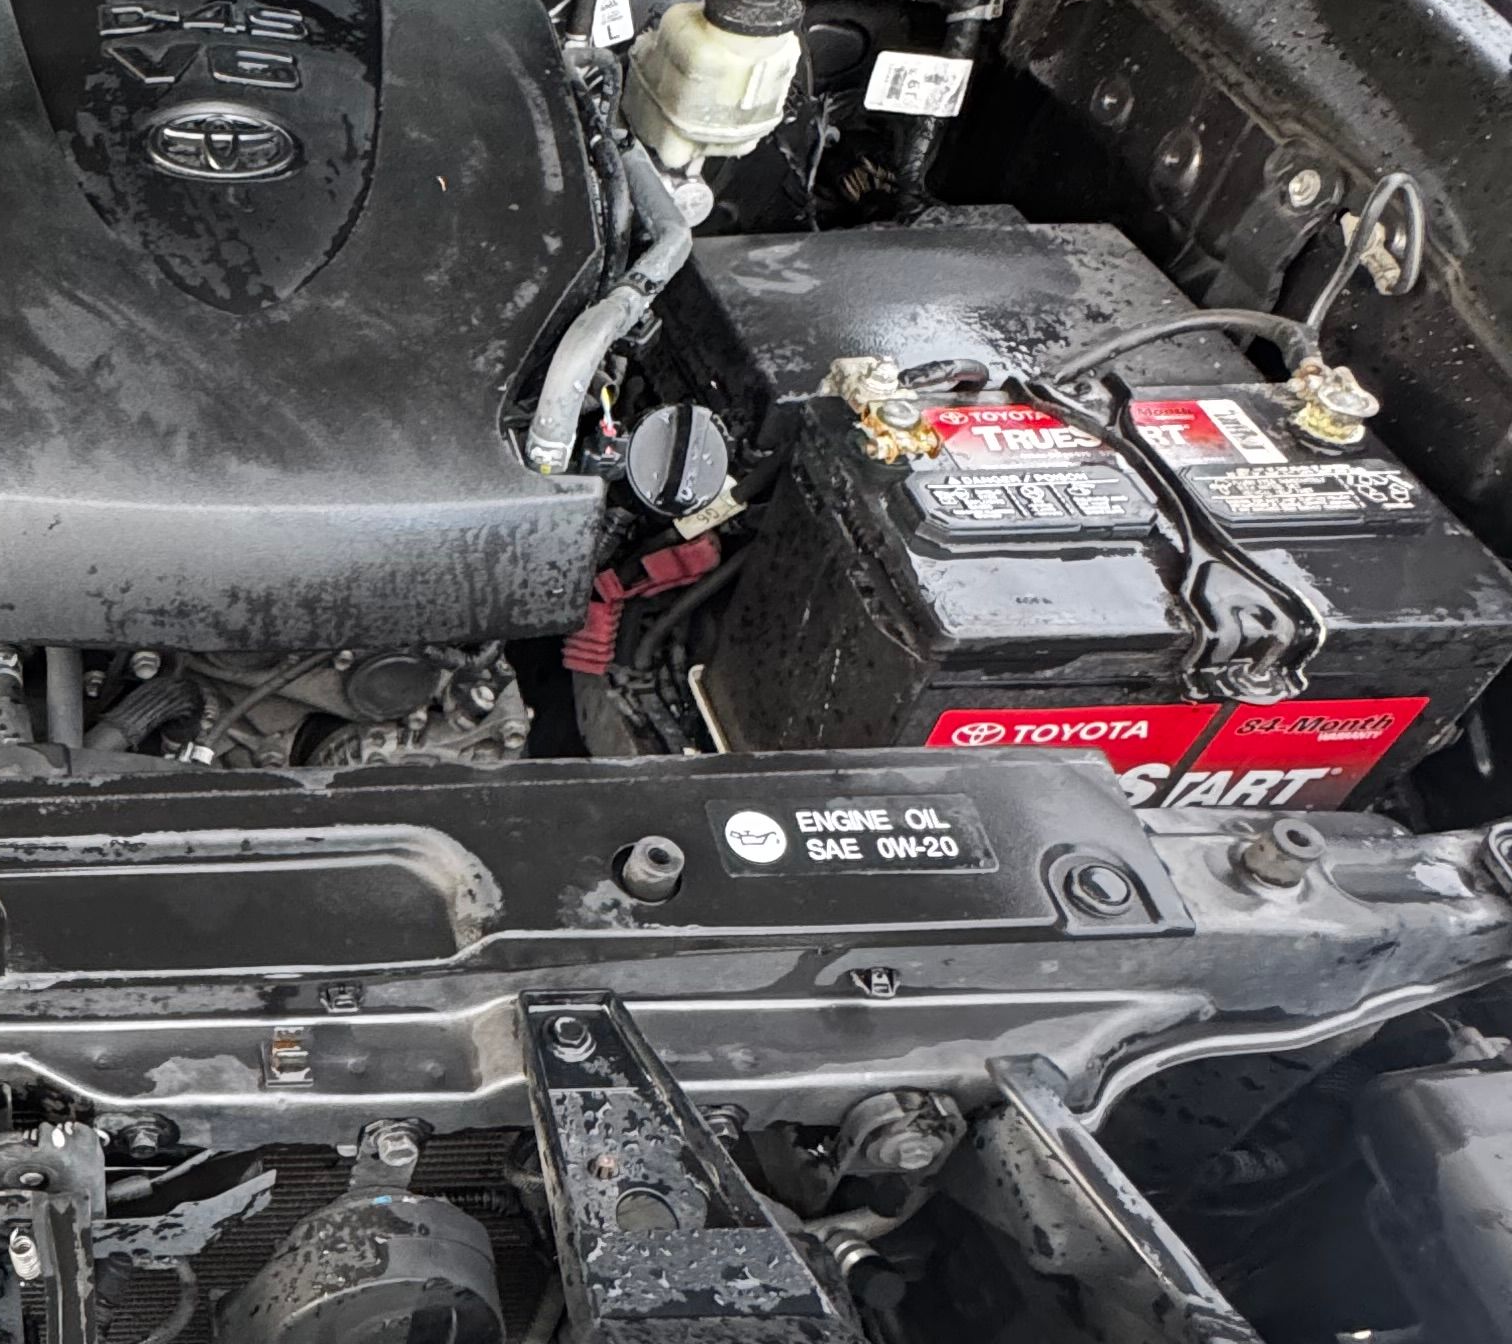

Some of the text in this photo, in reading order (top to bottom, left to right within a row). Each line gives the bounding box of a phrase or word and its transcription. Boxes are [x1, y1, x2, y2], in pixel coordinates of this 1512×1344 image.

[102, 42, 301, 90] V6
[968, 410, 1051, 423] TOYOTA
[1013, 720, 1149, 743] TOYOTA
[1235, 712, 1395, 735] 84-Month
[1115, 762, 1331, 807] START
[795, 807, 951, 833] ENGINE OIL
[806, 835, 960, 861] SAE 0W-20
